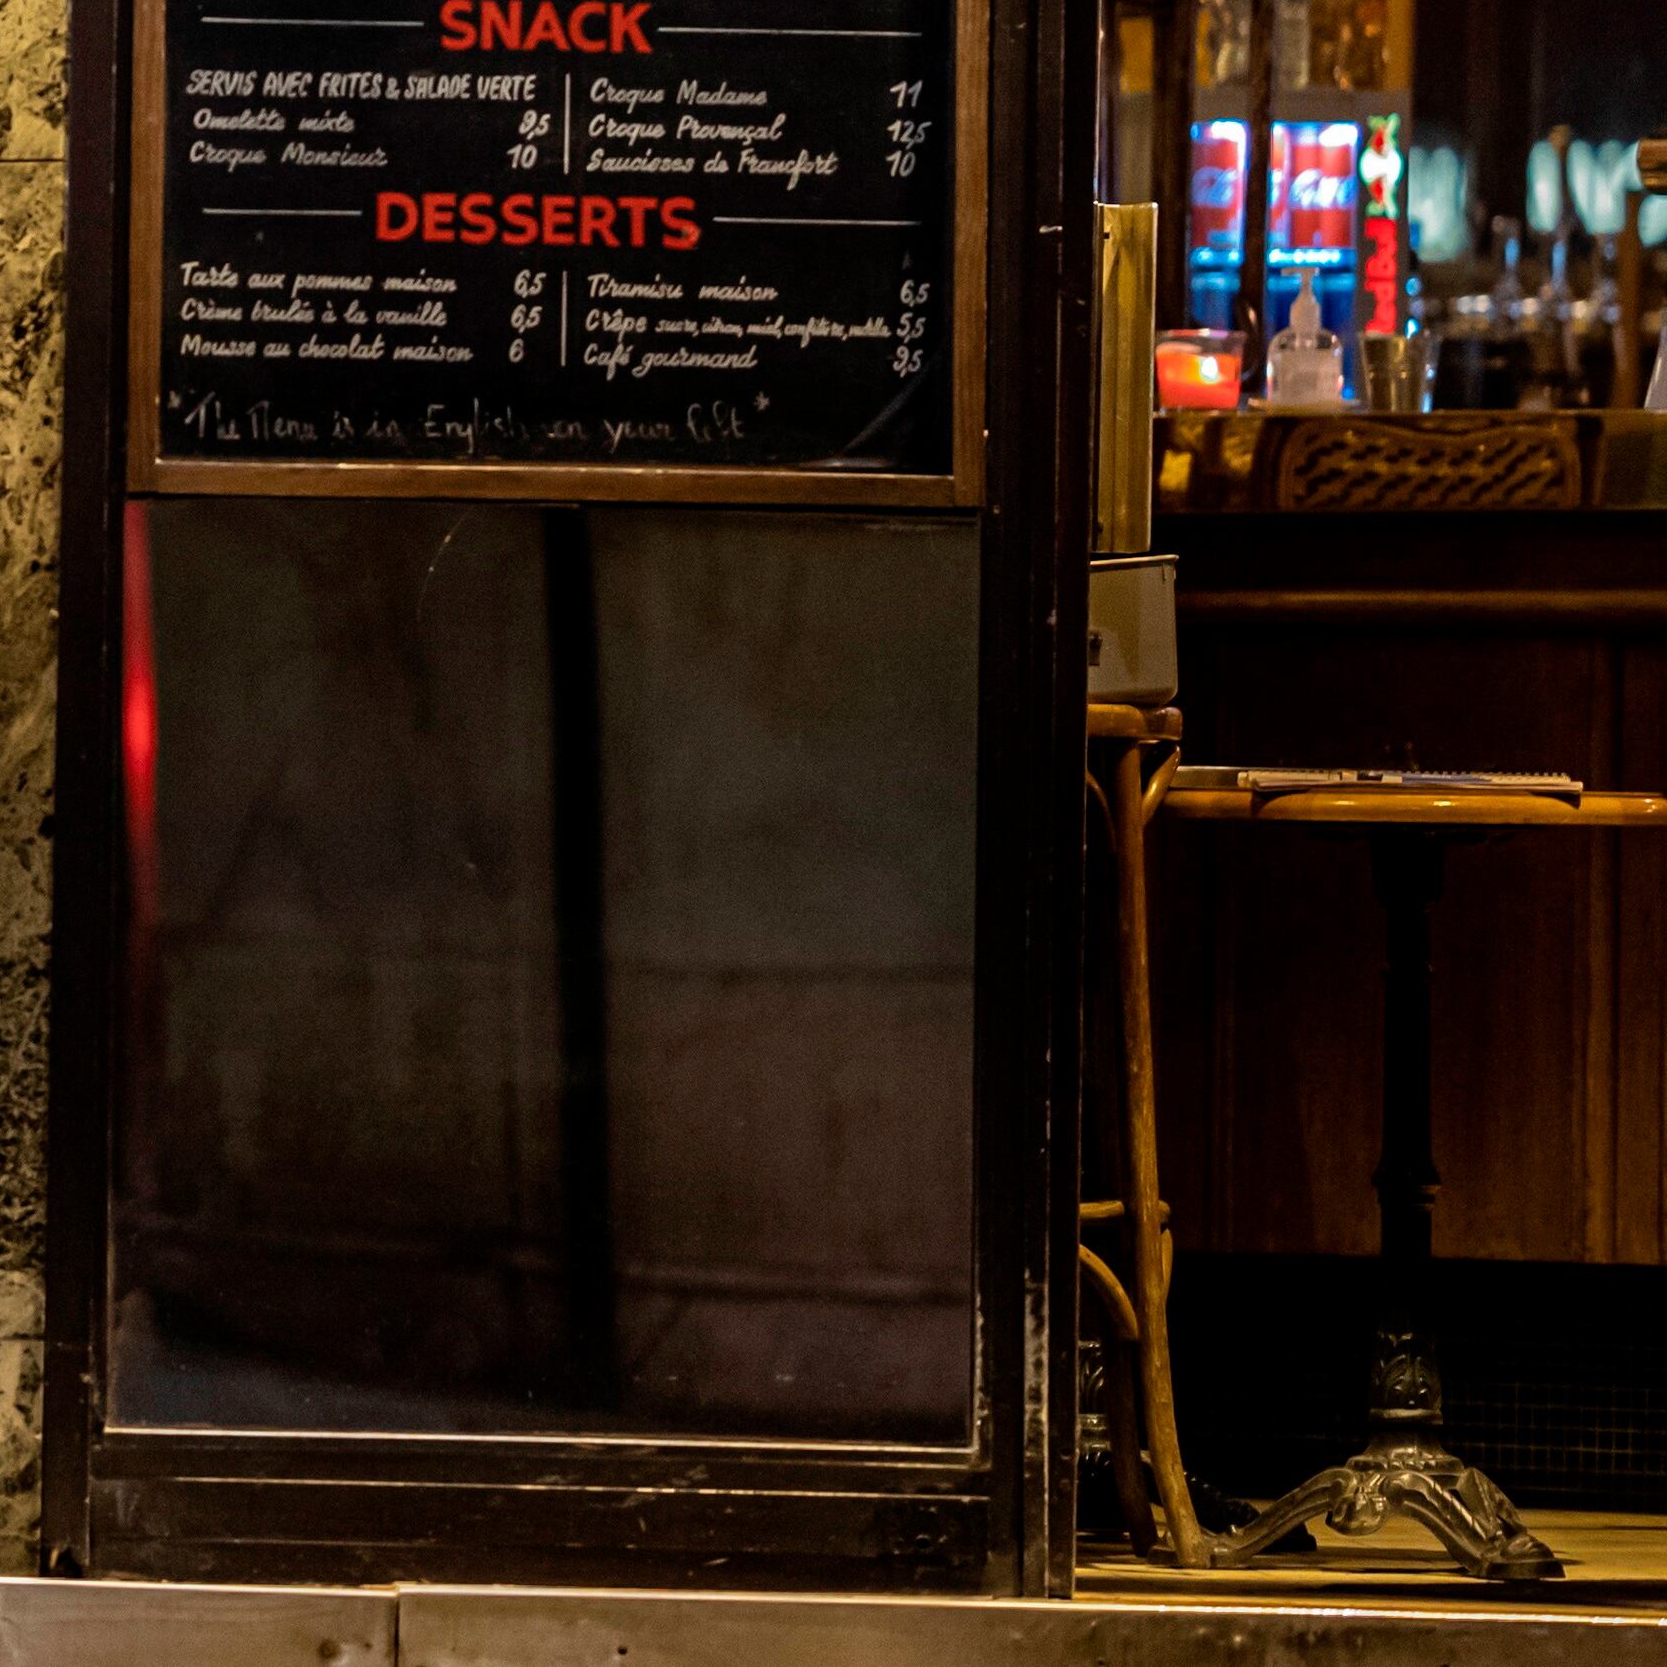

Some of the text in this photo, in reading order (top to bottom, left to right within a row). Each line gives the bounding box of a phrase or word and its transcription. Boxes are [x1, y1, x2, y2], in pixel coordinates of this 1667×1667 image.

[185, 69, 537, 101] SERVIS AVEC FRITES & SALADE VERTE
[589, 77, 923, 114] Croque Madame 11
[192, 107, 551, 140] Omelette mixte 9,5
[587, 113, 932, 149] Croque Provençal 12,5
[189, 140, 539, 172] Croque Monsieur 10
[586, 148, 916, 191] Saucisses de Francfort 10
[375, 191, 701, 250] DESSERTS
[180, 261, 547, 298] Tarte aux pommes maison 6,5
[587, 272, 930, 308] Tiramisu maison 6,5
[180, 297, 242, 321] Crème
[321, 301, 338, 325] à
[344, 300, 368, 325] la
[376, 301, 448, 327] vanille
[510, 304, 542, 334] 6,5
[585, 308, 647, 342] Crêpe
[896, 312, 926, 344] 5,5
[180, 334, 257, 358] Mousse
[262, 342, 291, 358] au
[298, 334, 385, 360] chocolat
[393, 335, 473, 362] maison
[583, 342, 924, 381] Café gourmand 9,5
